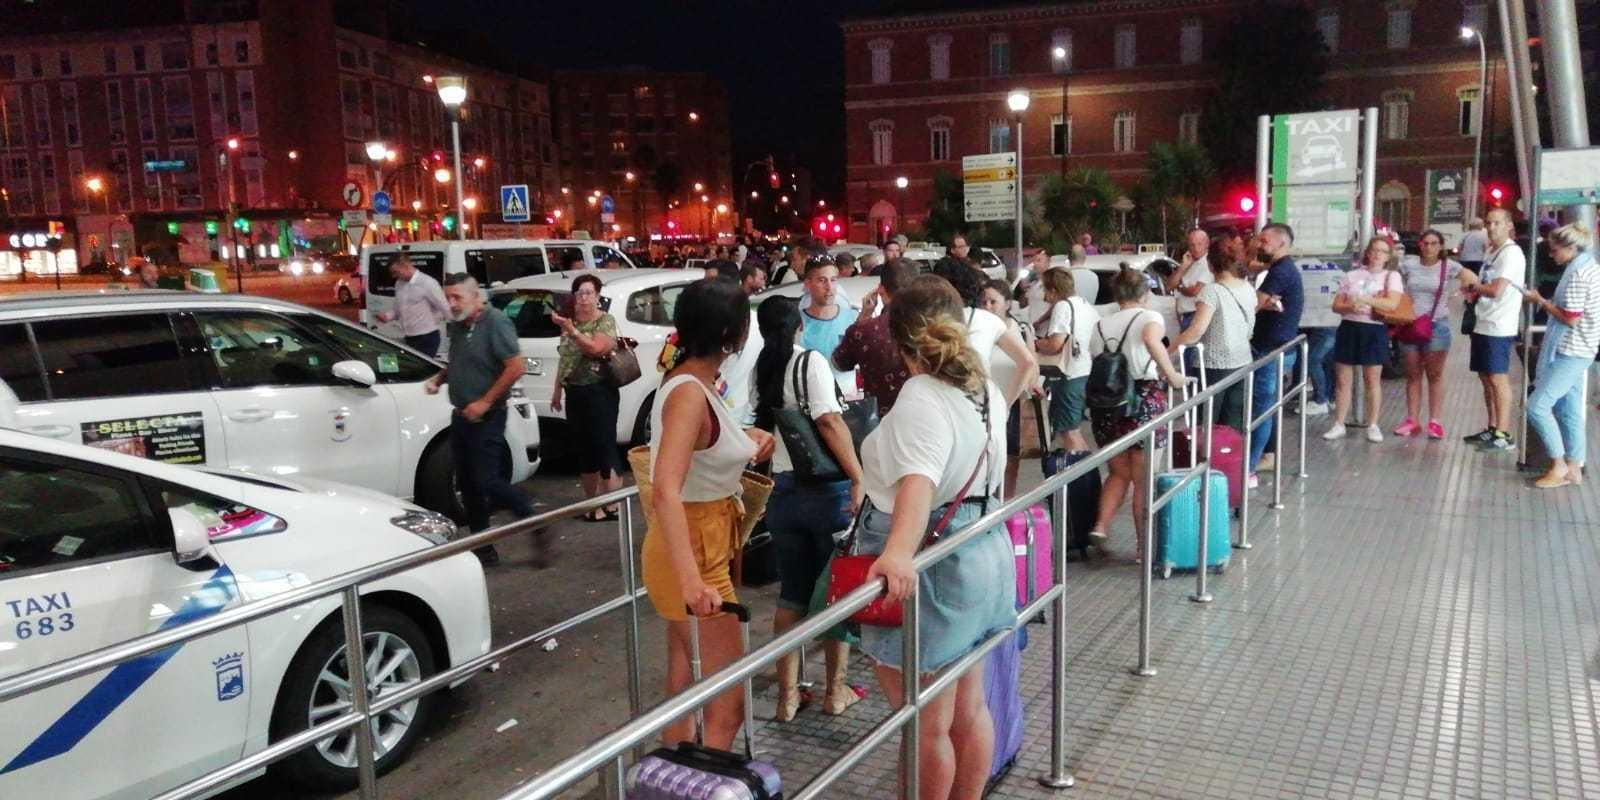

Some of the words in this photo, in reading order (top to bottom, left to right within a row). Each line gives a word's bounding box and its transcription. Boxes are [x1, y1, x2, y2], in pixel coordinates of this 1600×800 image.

[1284, 115, 1352, 135] TAXI
[5, 591, 72, 618] TAXI
[16, 612, 75, 640] 683
